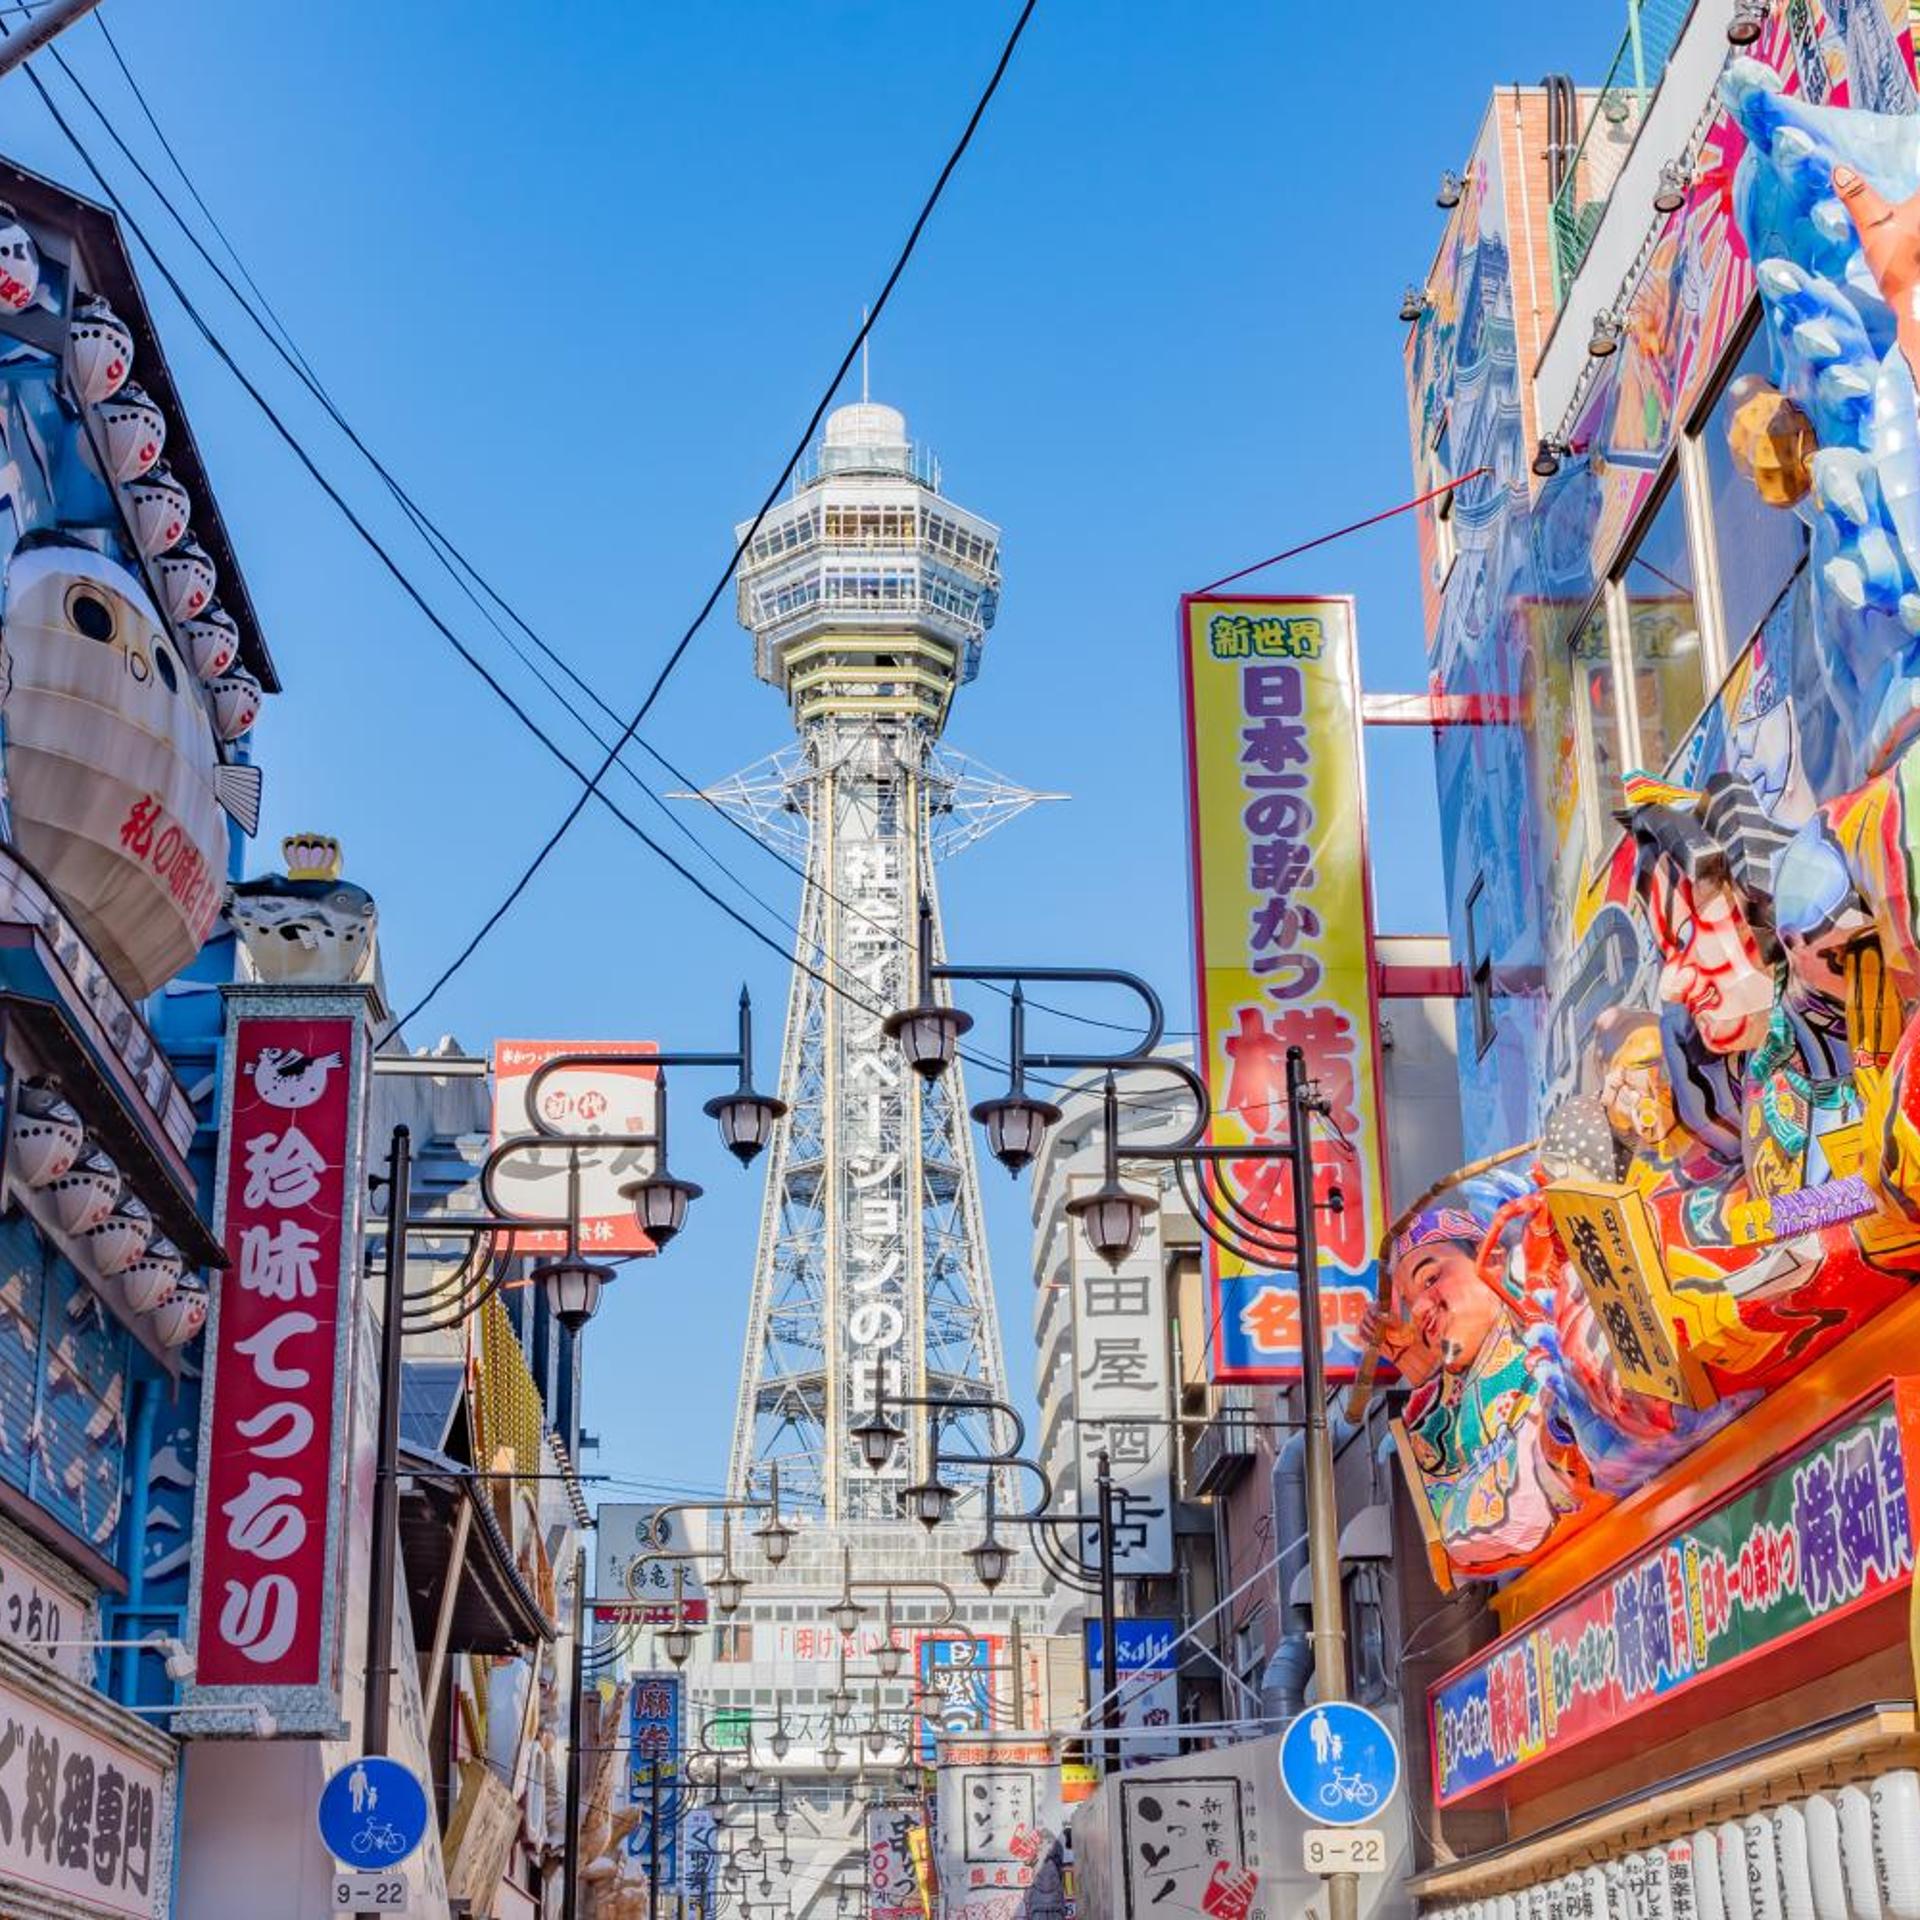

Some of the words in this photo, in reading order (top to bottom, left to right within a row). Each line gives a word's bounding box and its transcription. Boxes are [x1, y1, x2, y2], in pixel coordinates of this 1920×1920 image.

[1212, 617, 1326, 659] 新世界
[1241, 664, 1322, 1000] 日本一の串かつ
[1222, 1006, 1362, 1274] 横綱
[1243, 1286, 1368, 1358] 名門
[1080, 1225, 1165, 1560] 田屋酒店
[1793, 1428, 1888, 1614] 横綱
[338, 1876, 402, 1904] 9-22
[1311, 1841, 1379, 1863] 9-22
